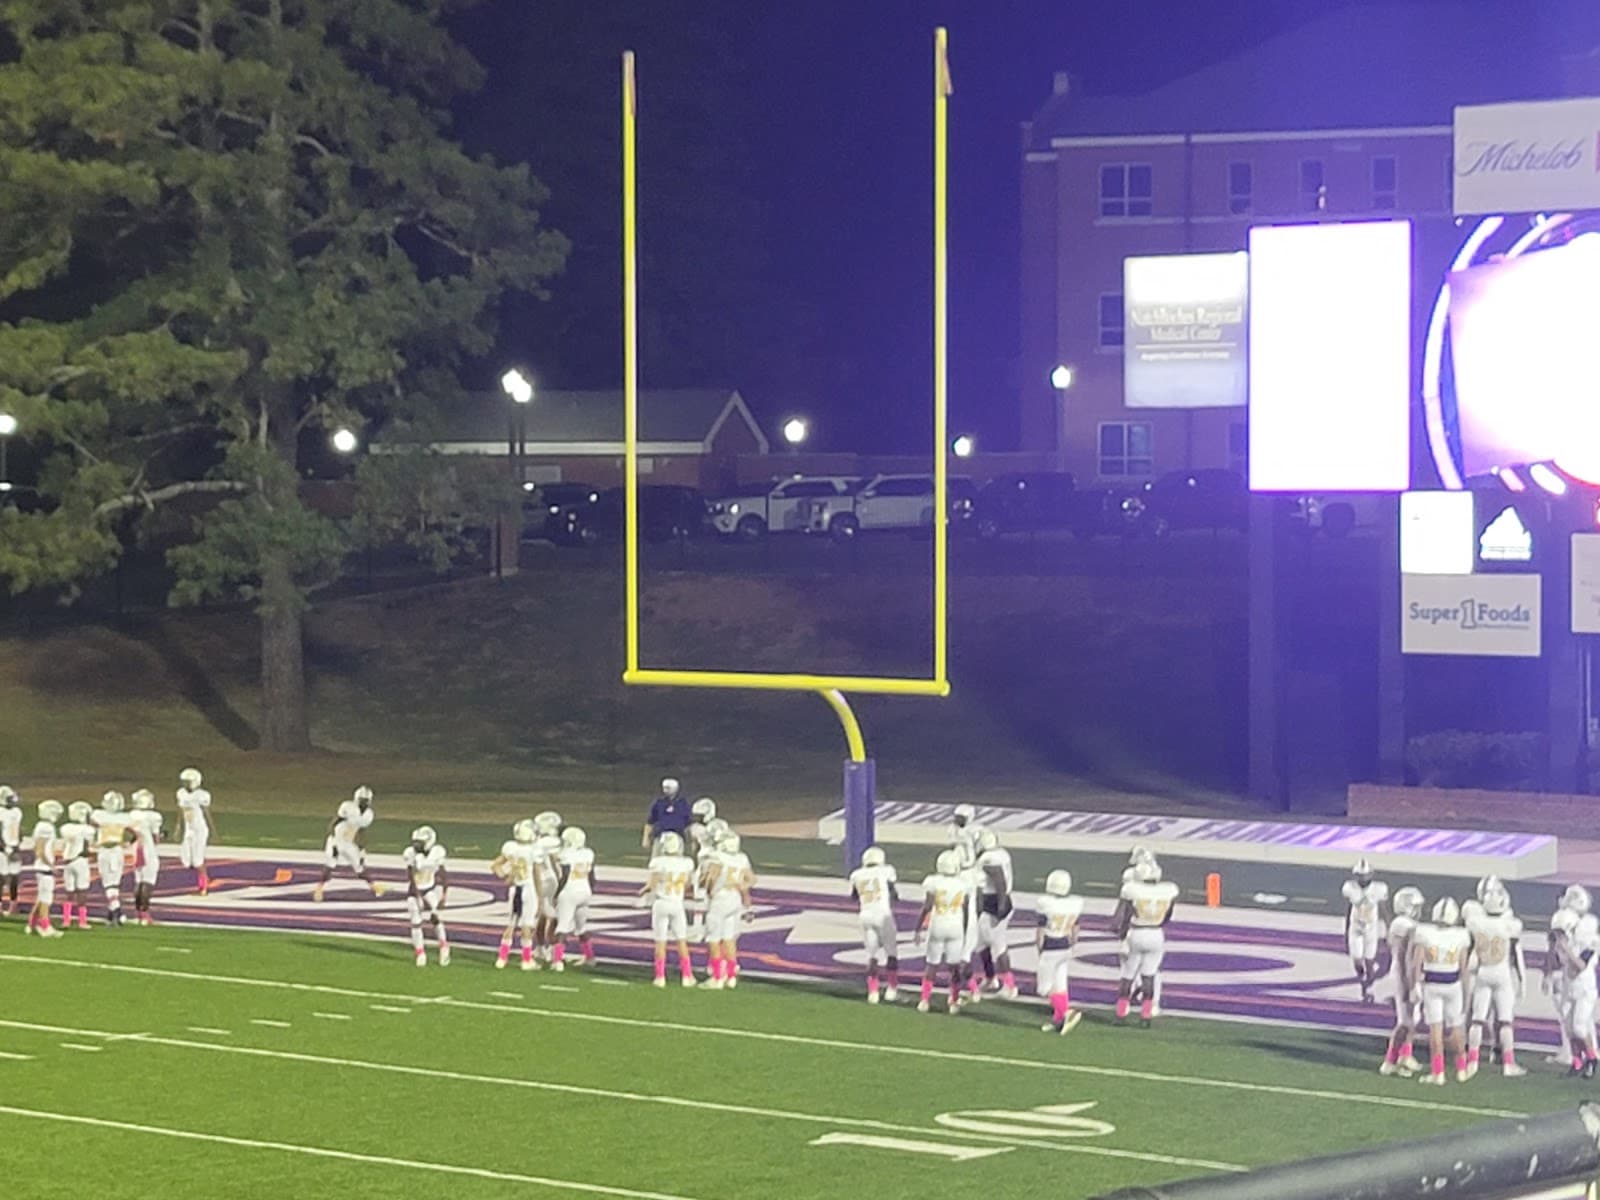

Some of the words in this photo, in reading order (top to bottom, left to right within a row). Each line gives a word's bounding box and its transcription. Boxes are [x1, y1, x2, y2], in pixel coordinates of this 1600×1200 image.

[1458, 138, 1585, 177] Michelob
[1409, 602, 1459, 624] Super
[1460, 599, 1477, 629] 1
[1477, 604, 1530, 622] Foods
[1017, 811, 1178, 835] LEWIS
[1366, 830, 1541, 855] PLAZA
